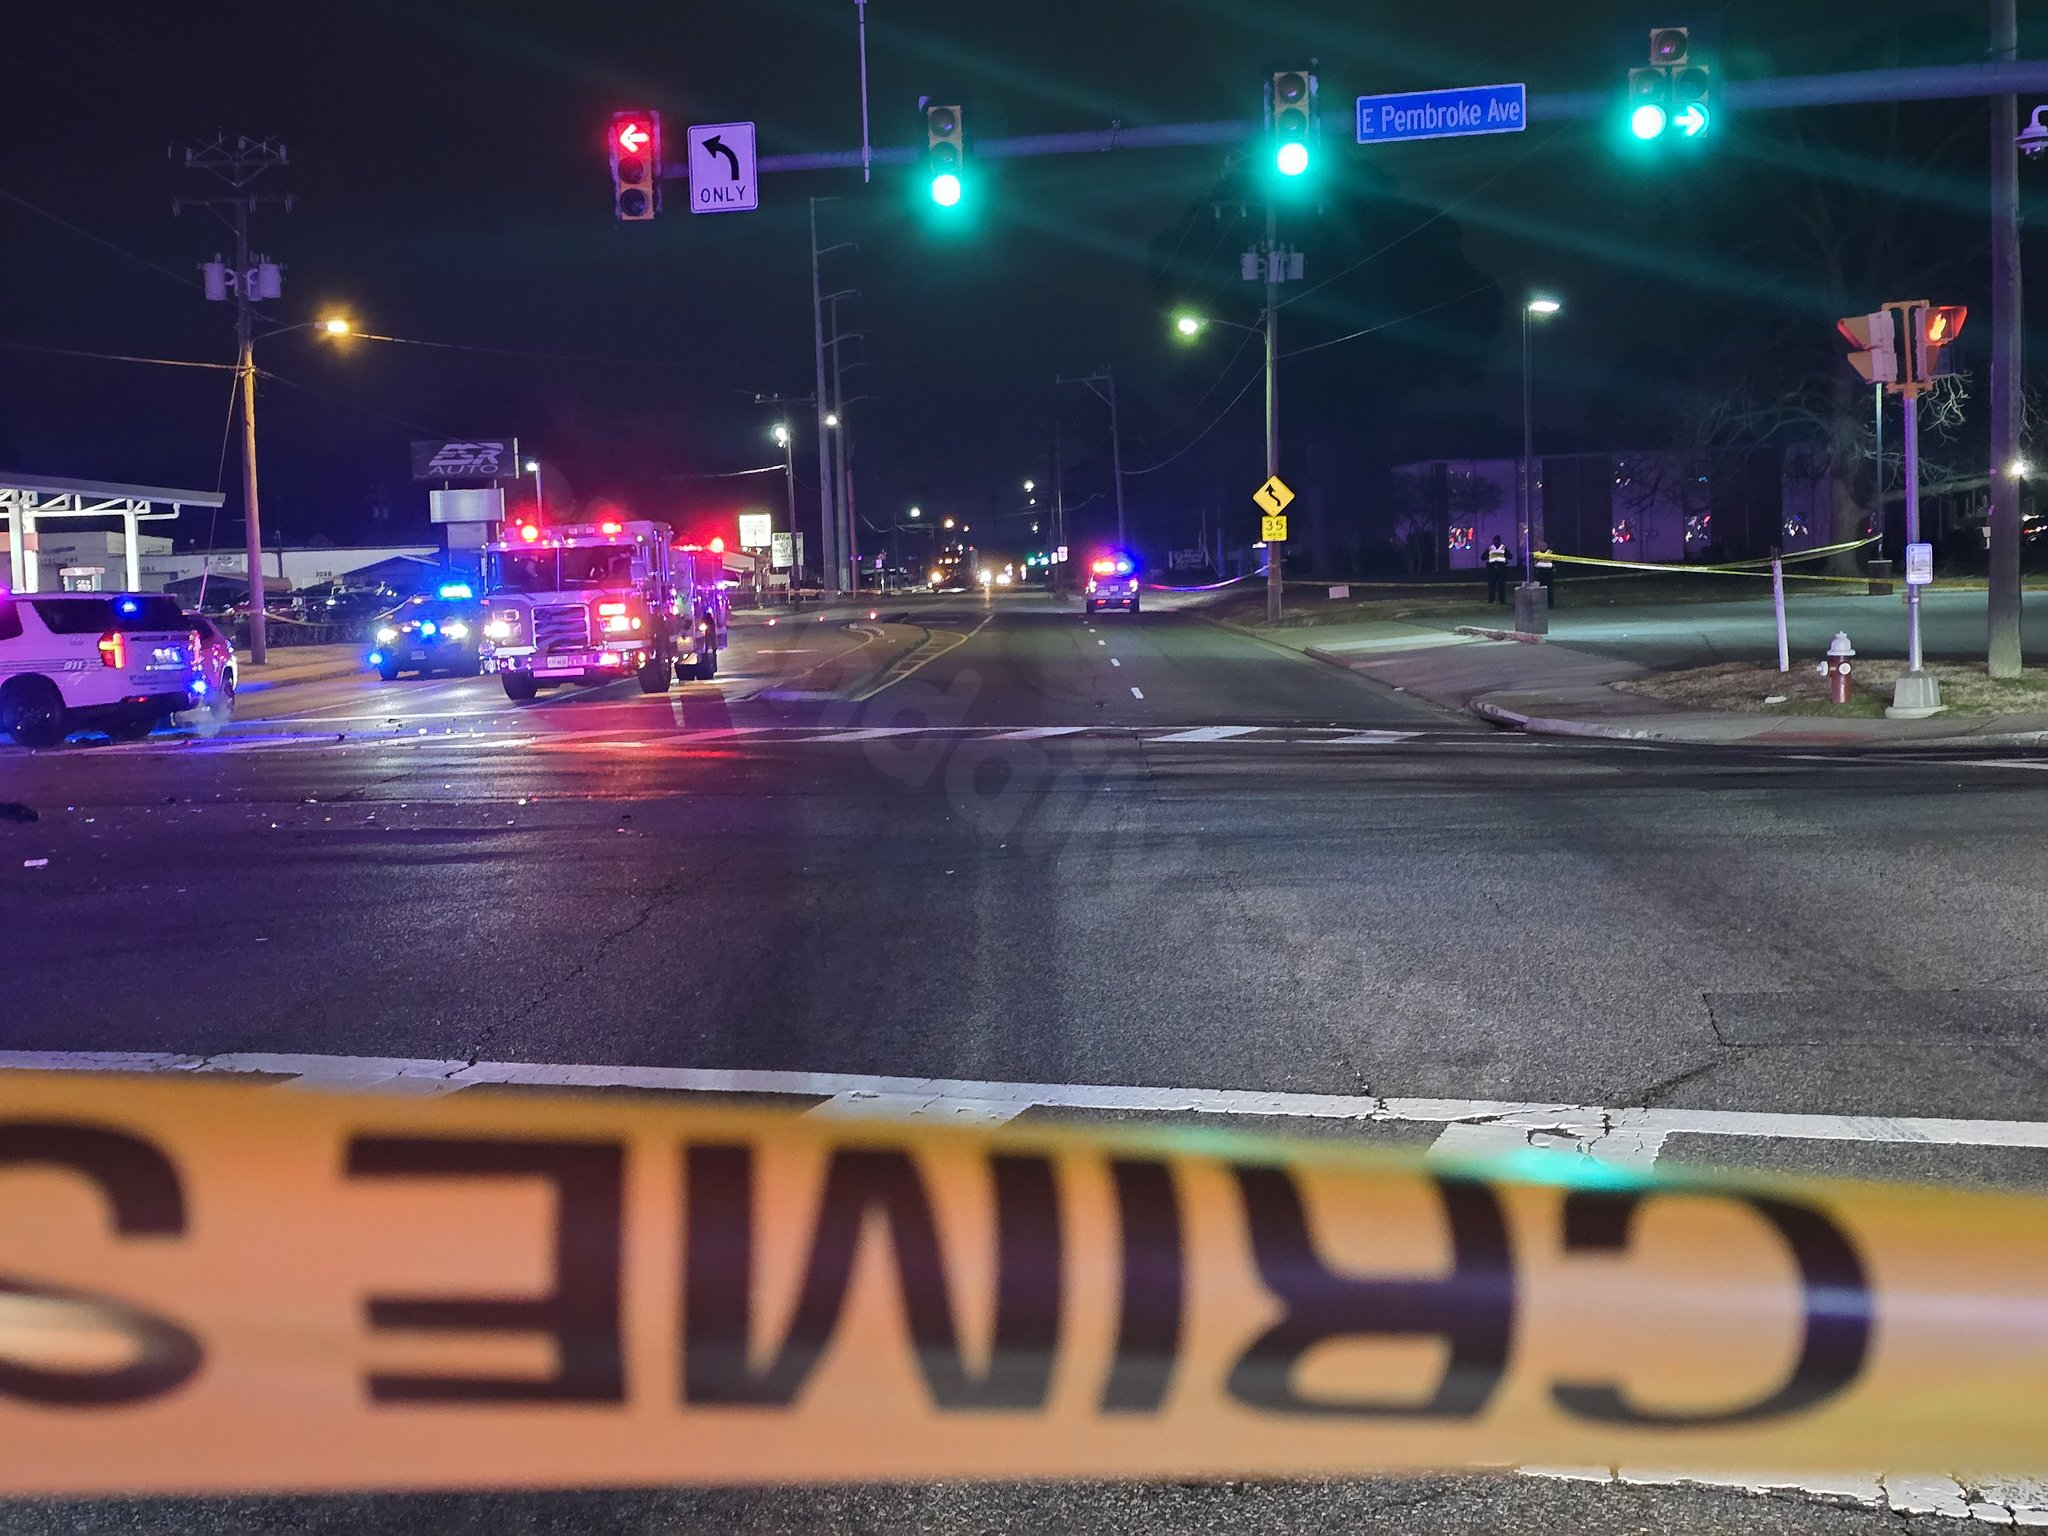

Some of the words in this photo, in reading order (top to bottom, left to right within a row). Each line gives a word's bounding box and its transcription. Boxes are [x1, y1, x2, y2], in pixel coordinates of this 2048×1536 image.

[1362, 108, 1375, 134] E
[1381, 100, 1482, 132] Pembroke
[1487, 97, 1521, 123] Ave
[700, 185, 746, 203] ONLY
[428, 464, 499, 475] AUTO
[1265, 520, 1284, 531] 35
[343, 1132, 1880, 1430] CRIME
